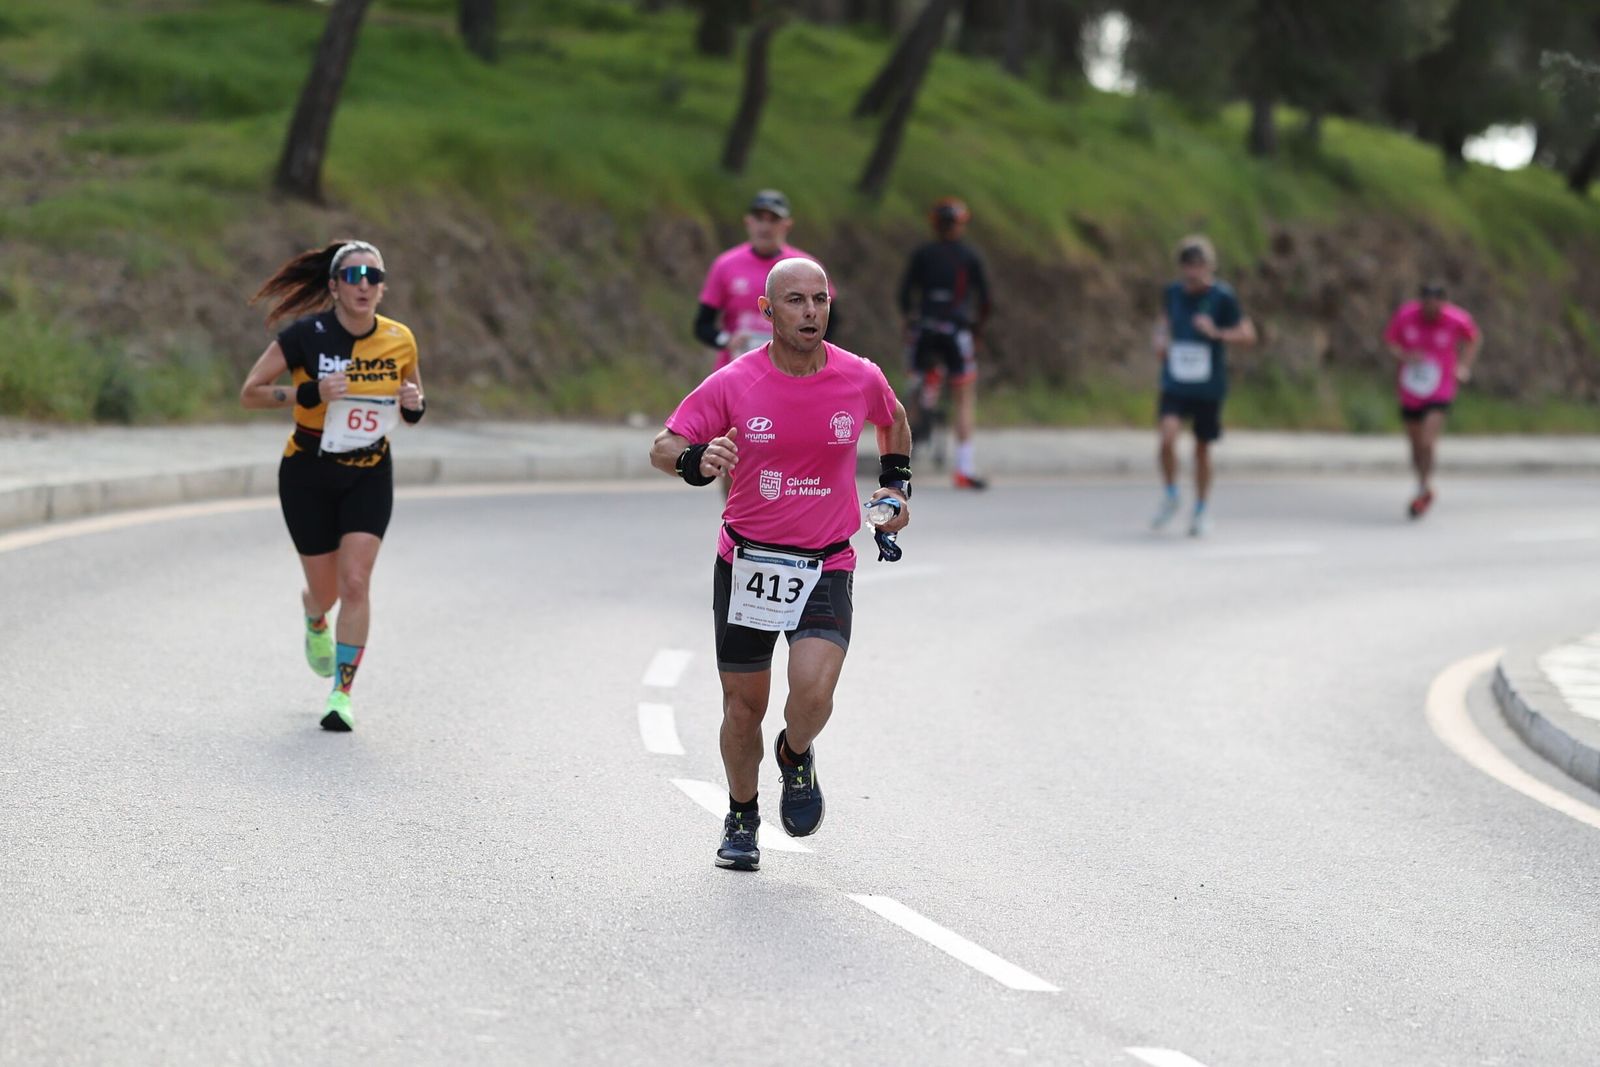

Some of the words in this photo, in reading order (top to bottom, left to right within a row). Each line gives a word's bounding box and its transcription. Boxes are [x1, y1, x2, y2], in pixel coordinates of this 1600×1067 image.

[318, 353, 397, 371] bichos
[318, 371, 398, 382] rnners
[348, 408, 378, 432] 65
[786, 477, 820, 486] Ciudad
[799, 486, 831, 497] Málaga
[746, 572, 804, 604] 413
